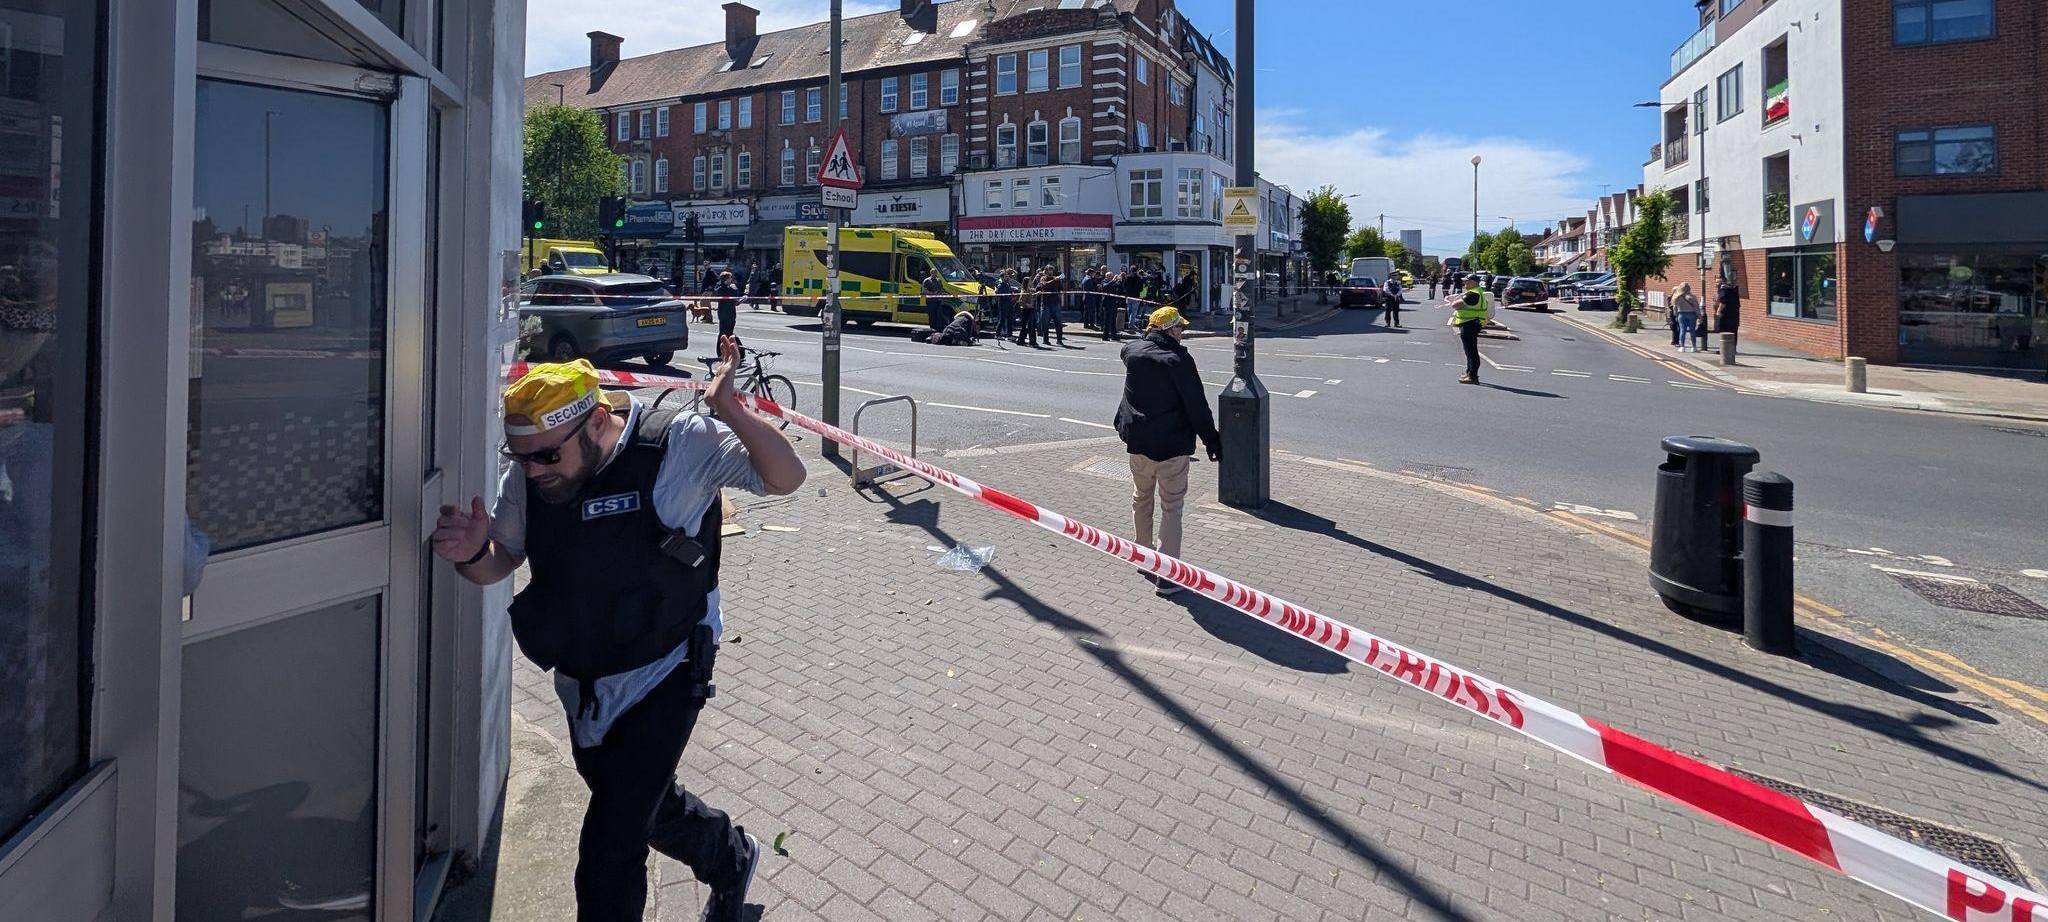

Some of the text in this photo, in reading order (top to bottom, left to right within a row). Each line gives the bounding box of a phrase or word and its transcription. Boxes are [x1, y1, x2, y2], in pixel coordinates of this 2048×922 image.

[825, 190, 854, 204] School
[712, 209, 727, 220] FOR
[729, 209, 745, 220] YOU
[801, 204, 831, 216] SILVE
[878, 202, 917, 213] LA FIESTA
[969, 228, 1055, 239] 2HR DRY CLEANERS
[546, 394, 595, 426] SECURITY
[587, 495, 634, 515] CST
[1364, 638, 1527, 730] CROSS
[1946, 866, 2048, 922] P
